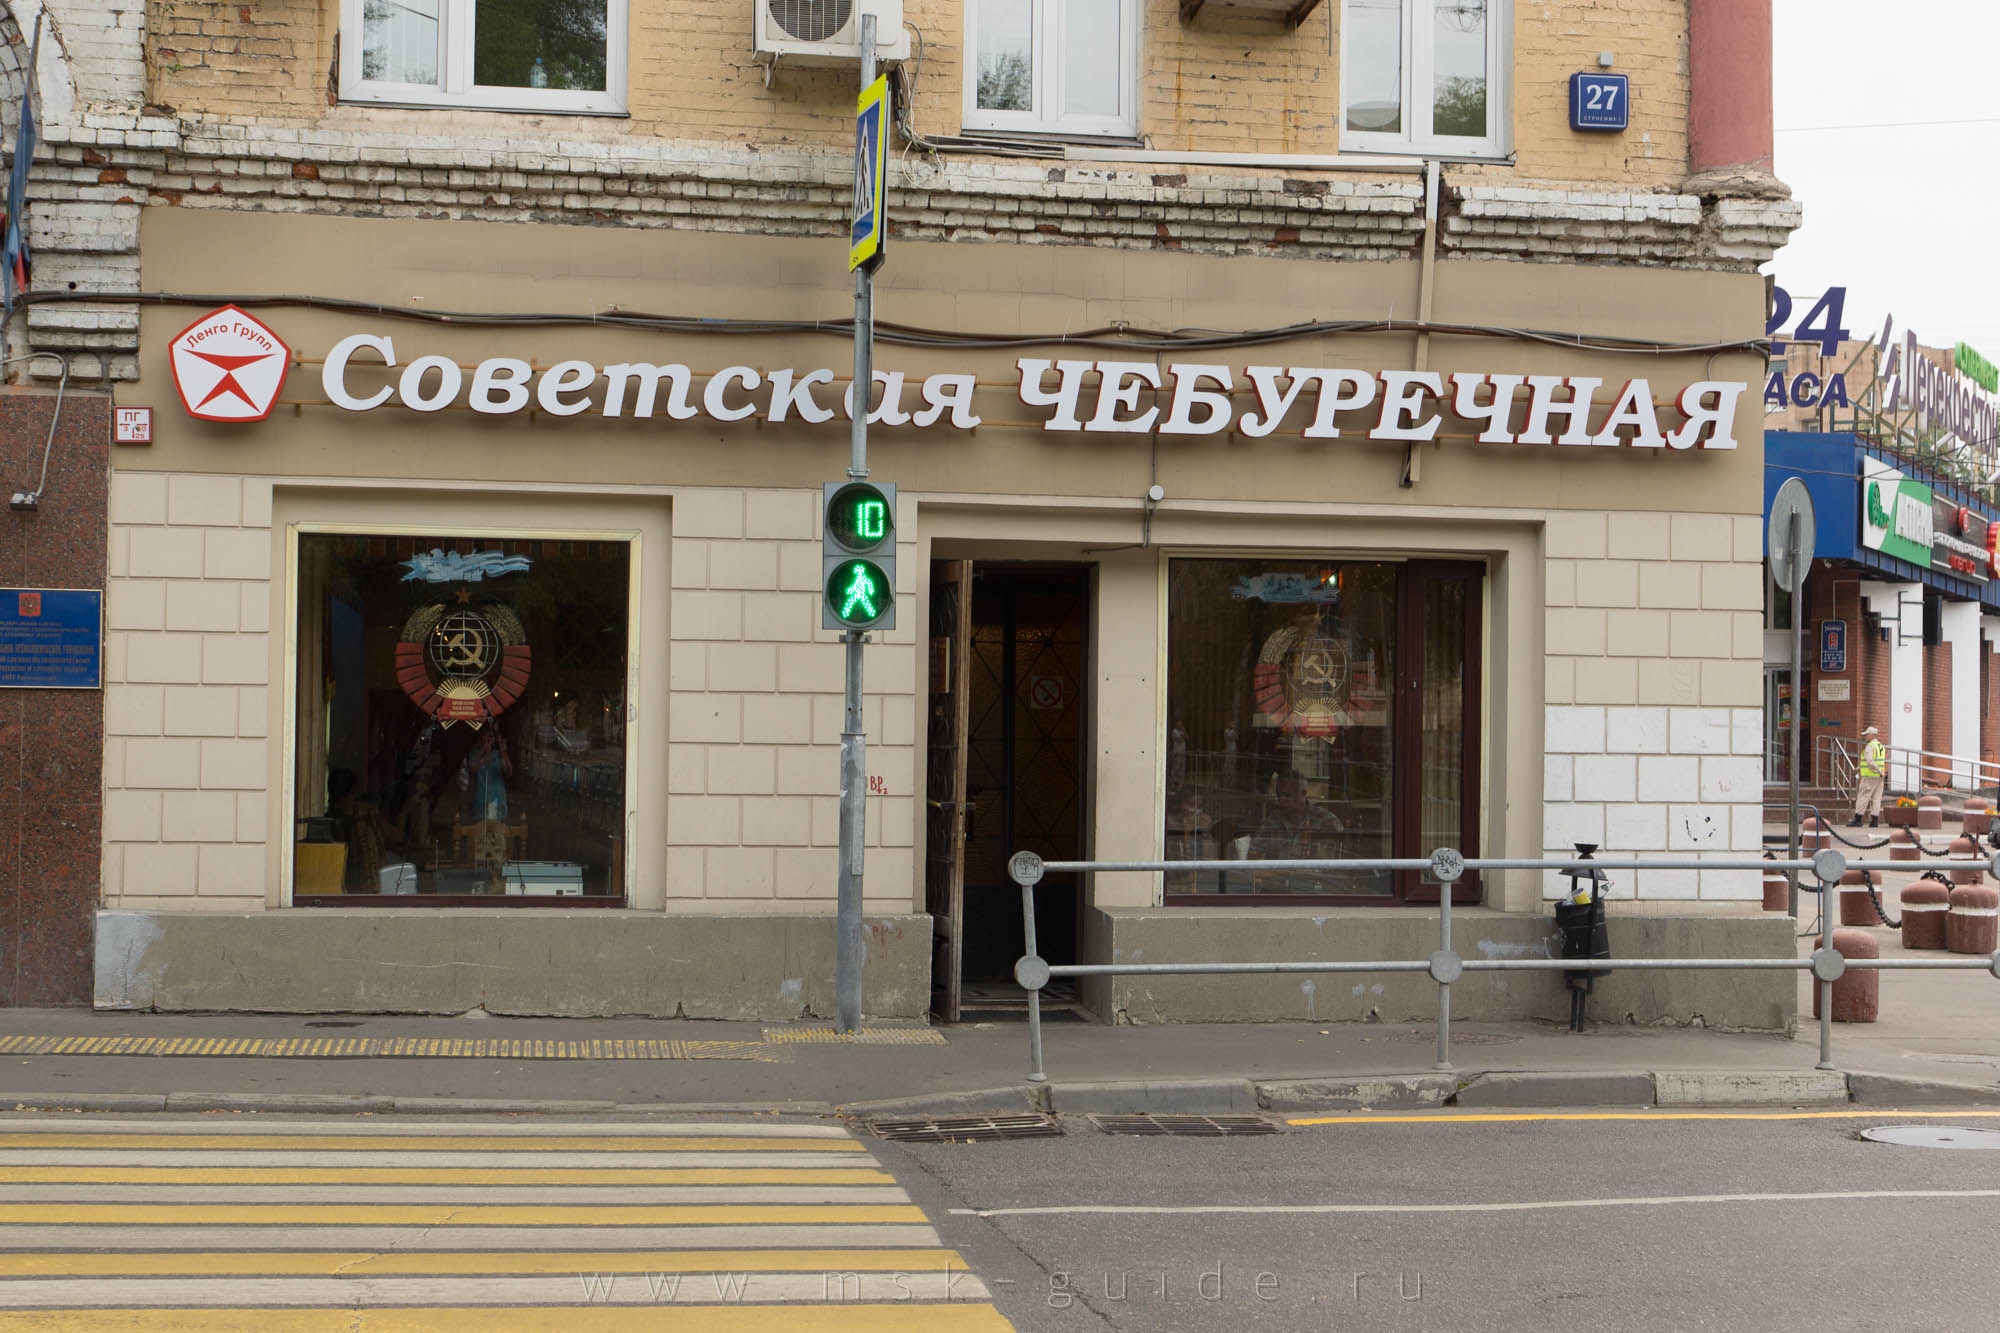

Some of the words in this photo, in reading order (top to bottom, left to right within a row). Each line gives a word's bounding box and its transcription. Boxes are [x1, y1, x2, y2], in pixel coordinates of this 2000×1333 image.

[1586, 84, 1619, 110] 27
[186, 324, 228, 348] Ленго
[233, 322, 272, 351] Групп
[321, 333, 982, 430] Советская
[1015, 358, 1748, 450] ЧЕБУРЕЧНАЯ
[125, 411, 141, 422] ПГ
[857, 502, 883, 537] 10
